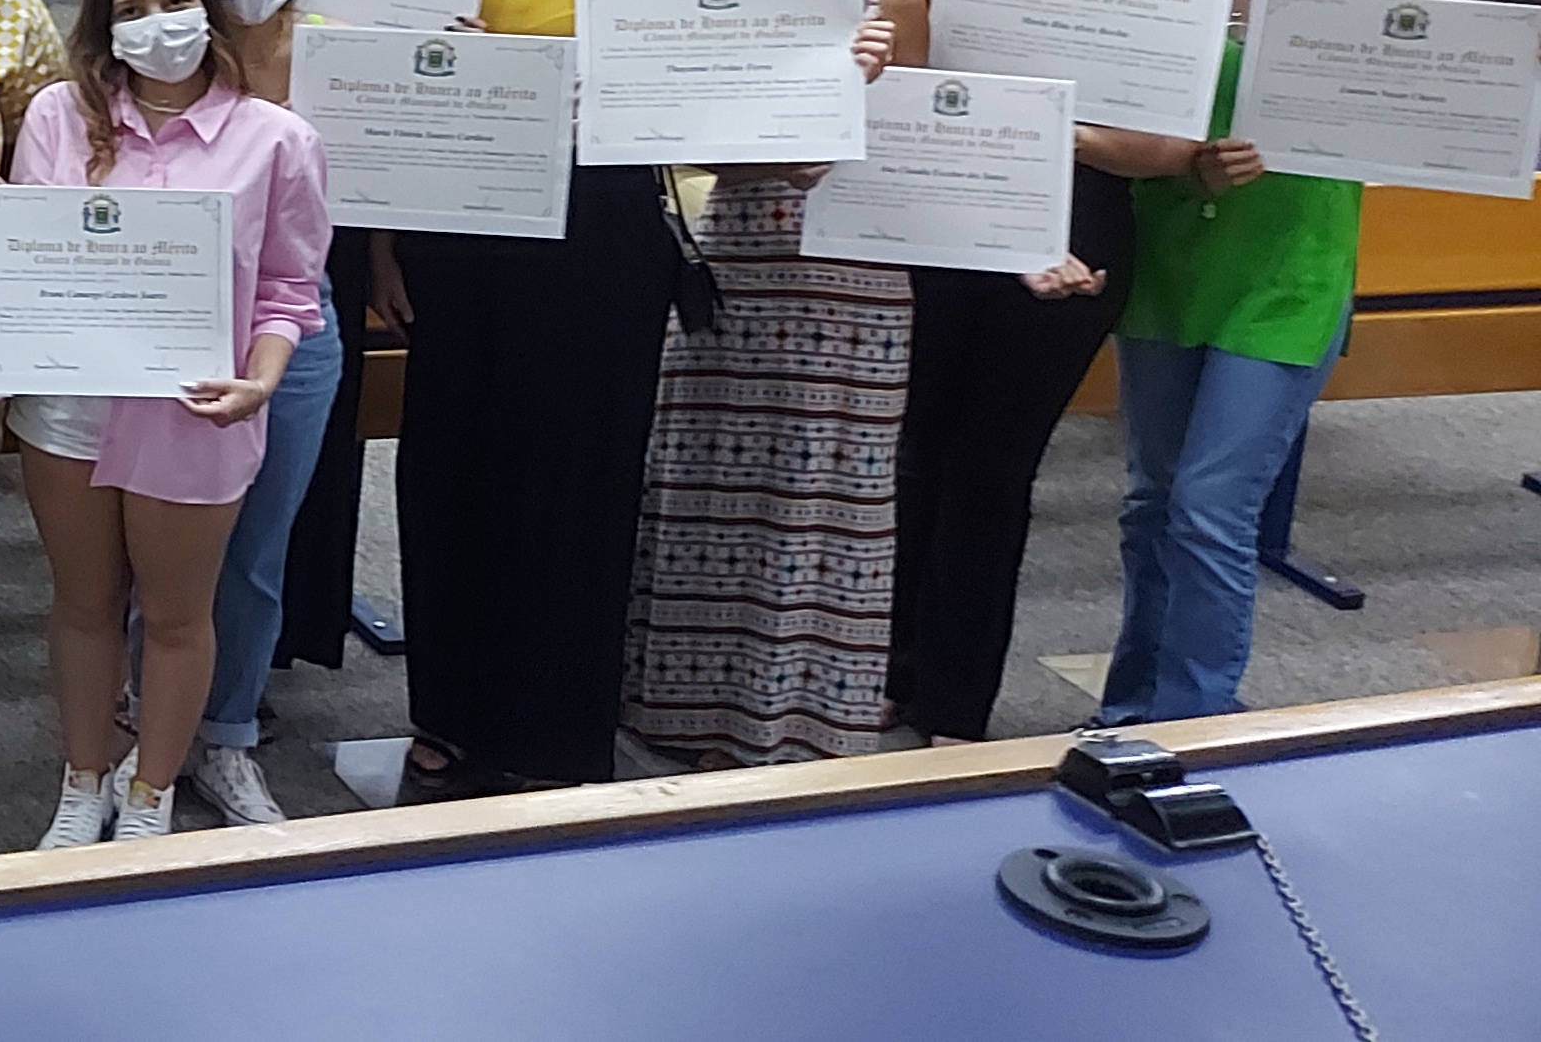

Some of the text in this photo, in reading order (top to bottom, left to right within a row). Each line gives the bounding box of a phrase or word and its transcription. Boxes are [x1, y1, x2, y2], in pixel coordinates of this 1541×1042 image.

[613, 17, 675, 32] Diploma
[679, 17, 695, 29] de
[700, 15, 747, 30] Honra
[751, 17, 769, 27] ao
[328, 77, 390, 93] Diploma
[393, 81, 410, 94] de
[414, 81, 461, 97] Honra
[465, 87, 482, 98] ao
[6, 237, 63, 254] Diploma
[65, 240, 81, 253] de
[84, 238, 129, 254] Honra
[131, 243, 147, 254] ao
